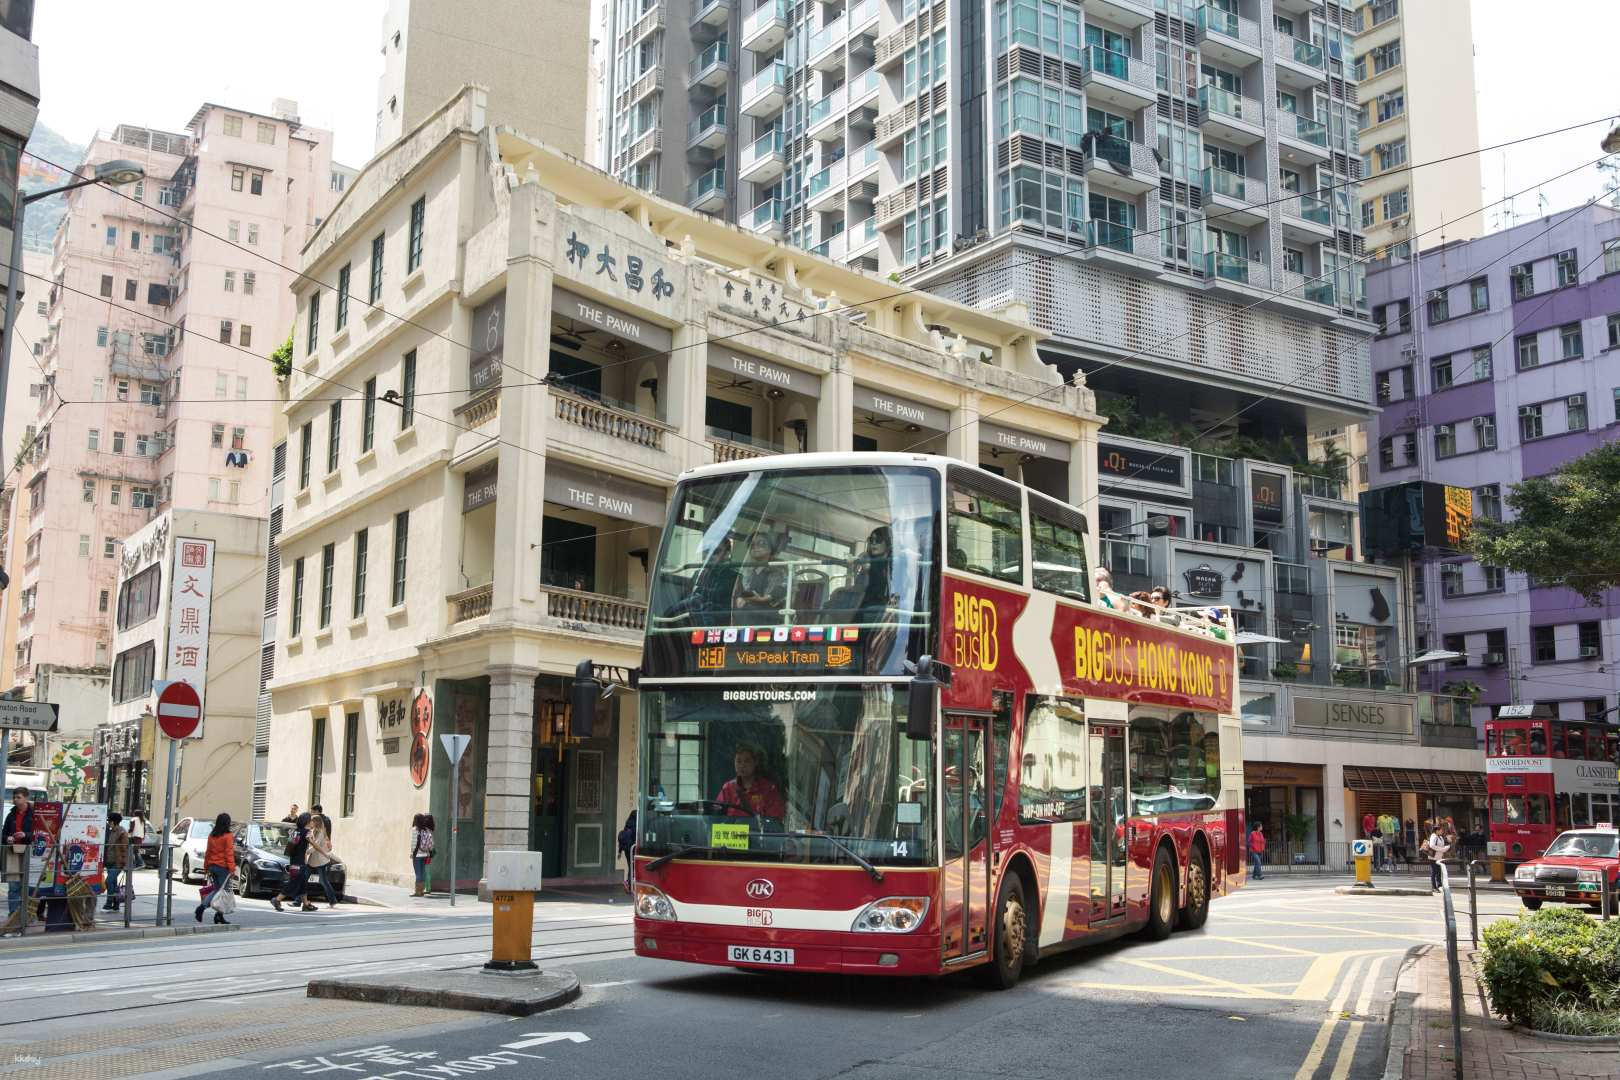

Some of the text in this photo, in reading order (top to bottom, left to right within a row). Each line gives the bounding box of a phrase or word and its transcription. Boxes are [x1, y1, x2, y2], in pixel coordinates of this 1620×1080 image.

[577, 303, 641, 338] THE PAWN
[474, 367, 489, 386] THE
[731, 356, 791, 385] THE PAWN
[872, 398, 925, 422] THE PAWN
[997, 432, 1047, 453] THE PAWN
[468, 488, 482, 507] THE
[568, 487, 634, 516] THE PAWN
[954, 592, 979, 632] BIG
[955, 632, 980, 670] BUS
[1137, 640, 1177, 692] HONG
[1180, 650, 1213, 698] KONG
[723, 691, 816, 701] BIGBUSTOURS.COM
[19, 704, 37, 713] Road
[1332, 703, 1385, 725] SENSES
[1504, 706, 1525, 715] 152
[1023, 802, 1065, 818] HOP-ON HOP-OFF
[890, 841, 908, 857] 14
[747, 908, 761, 917] BIG
[733, 948, 789, 963] GK 6431
[415, 1051, 546, 1077] LOOK
